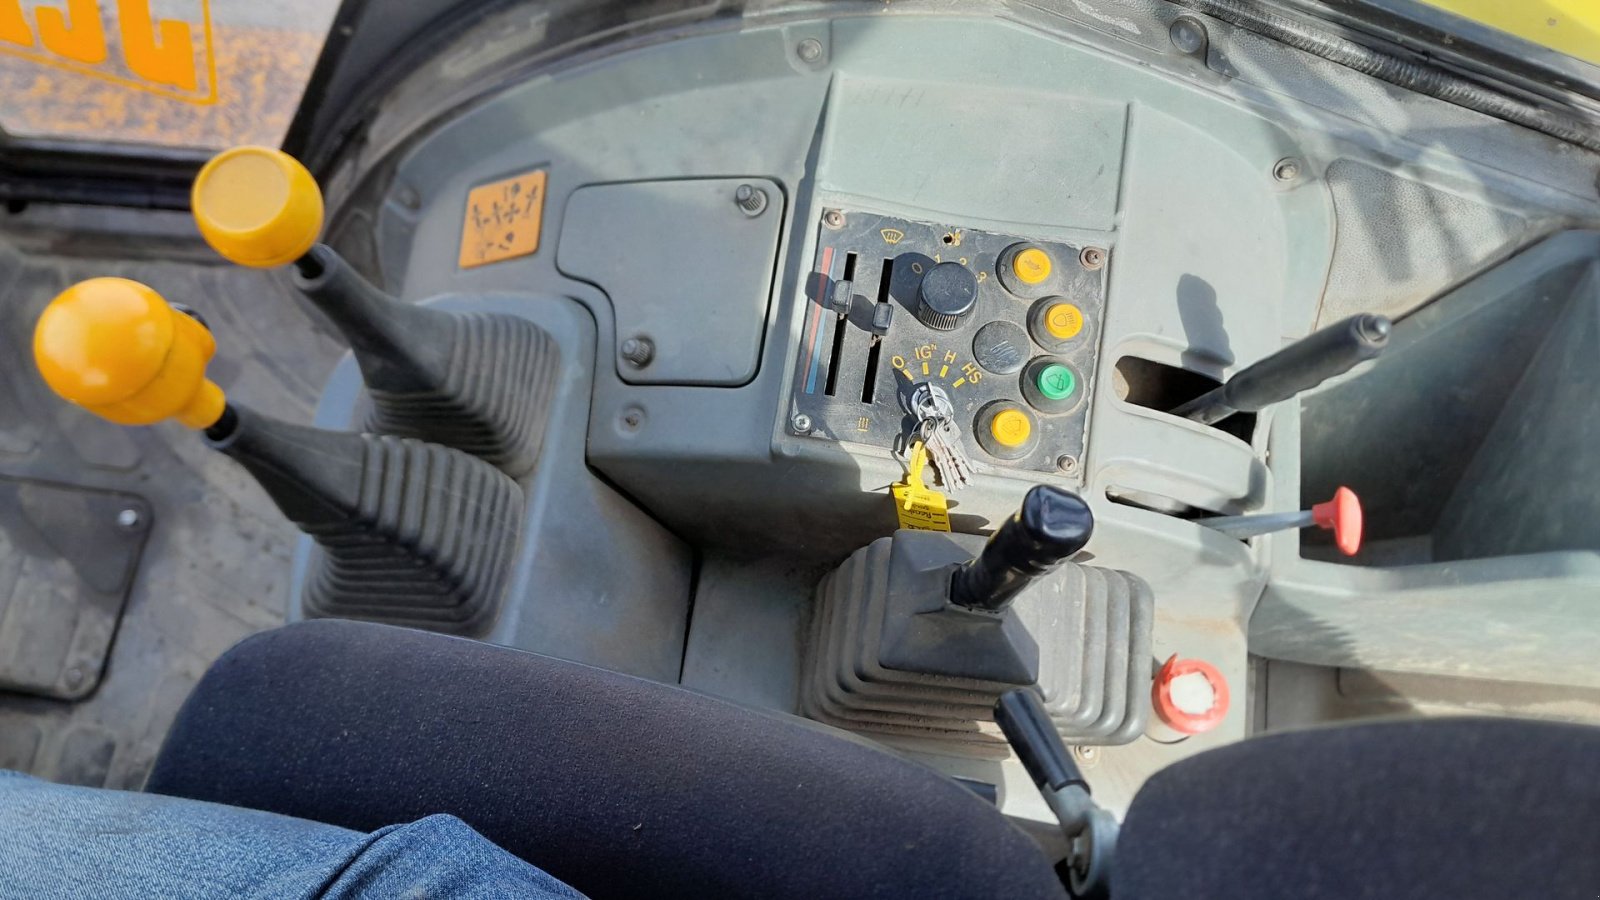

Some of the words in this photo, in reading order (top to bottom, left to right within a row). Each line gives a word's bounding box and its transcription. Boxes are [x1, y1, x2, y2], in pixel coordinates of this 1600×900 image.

[977, 271, 987, 283] 3
[943, 349, 957, 364] H
[961, 362, 982, 384] HS
